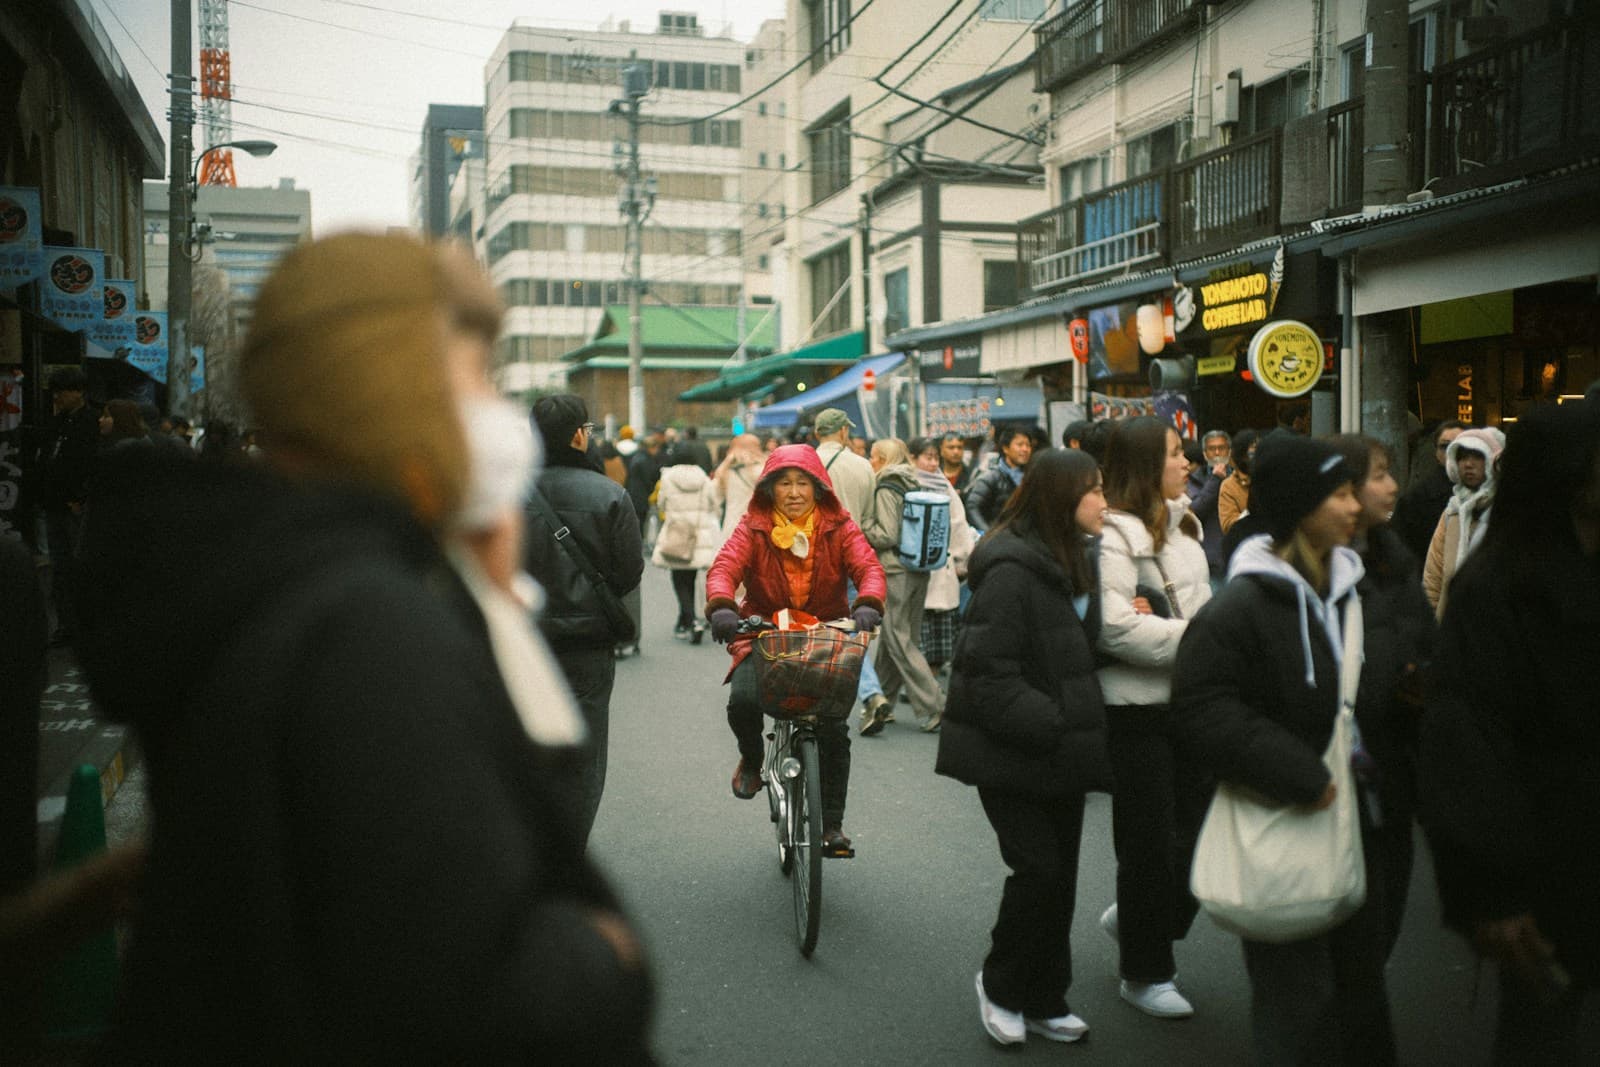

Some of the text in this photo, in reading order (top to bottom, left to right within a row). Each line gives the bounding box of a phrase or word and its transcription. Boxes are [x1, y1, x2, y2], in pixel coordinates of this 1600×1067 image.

[1201, 273, 1267, 306] YONEMOTO
[1203, 299, 1267, 331] COFFEE LAB
[1275, 332, 1307, 342] YONEMOTO
[1458, 365, 1472, 424] EE LAB
